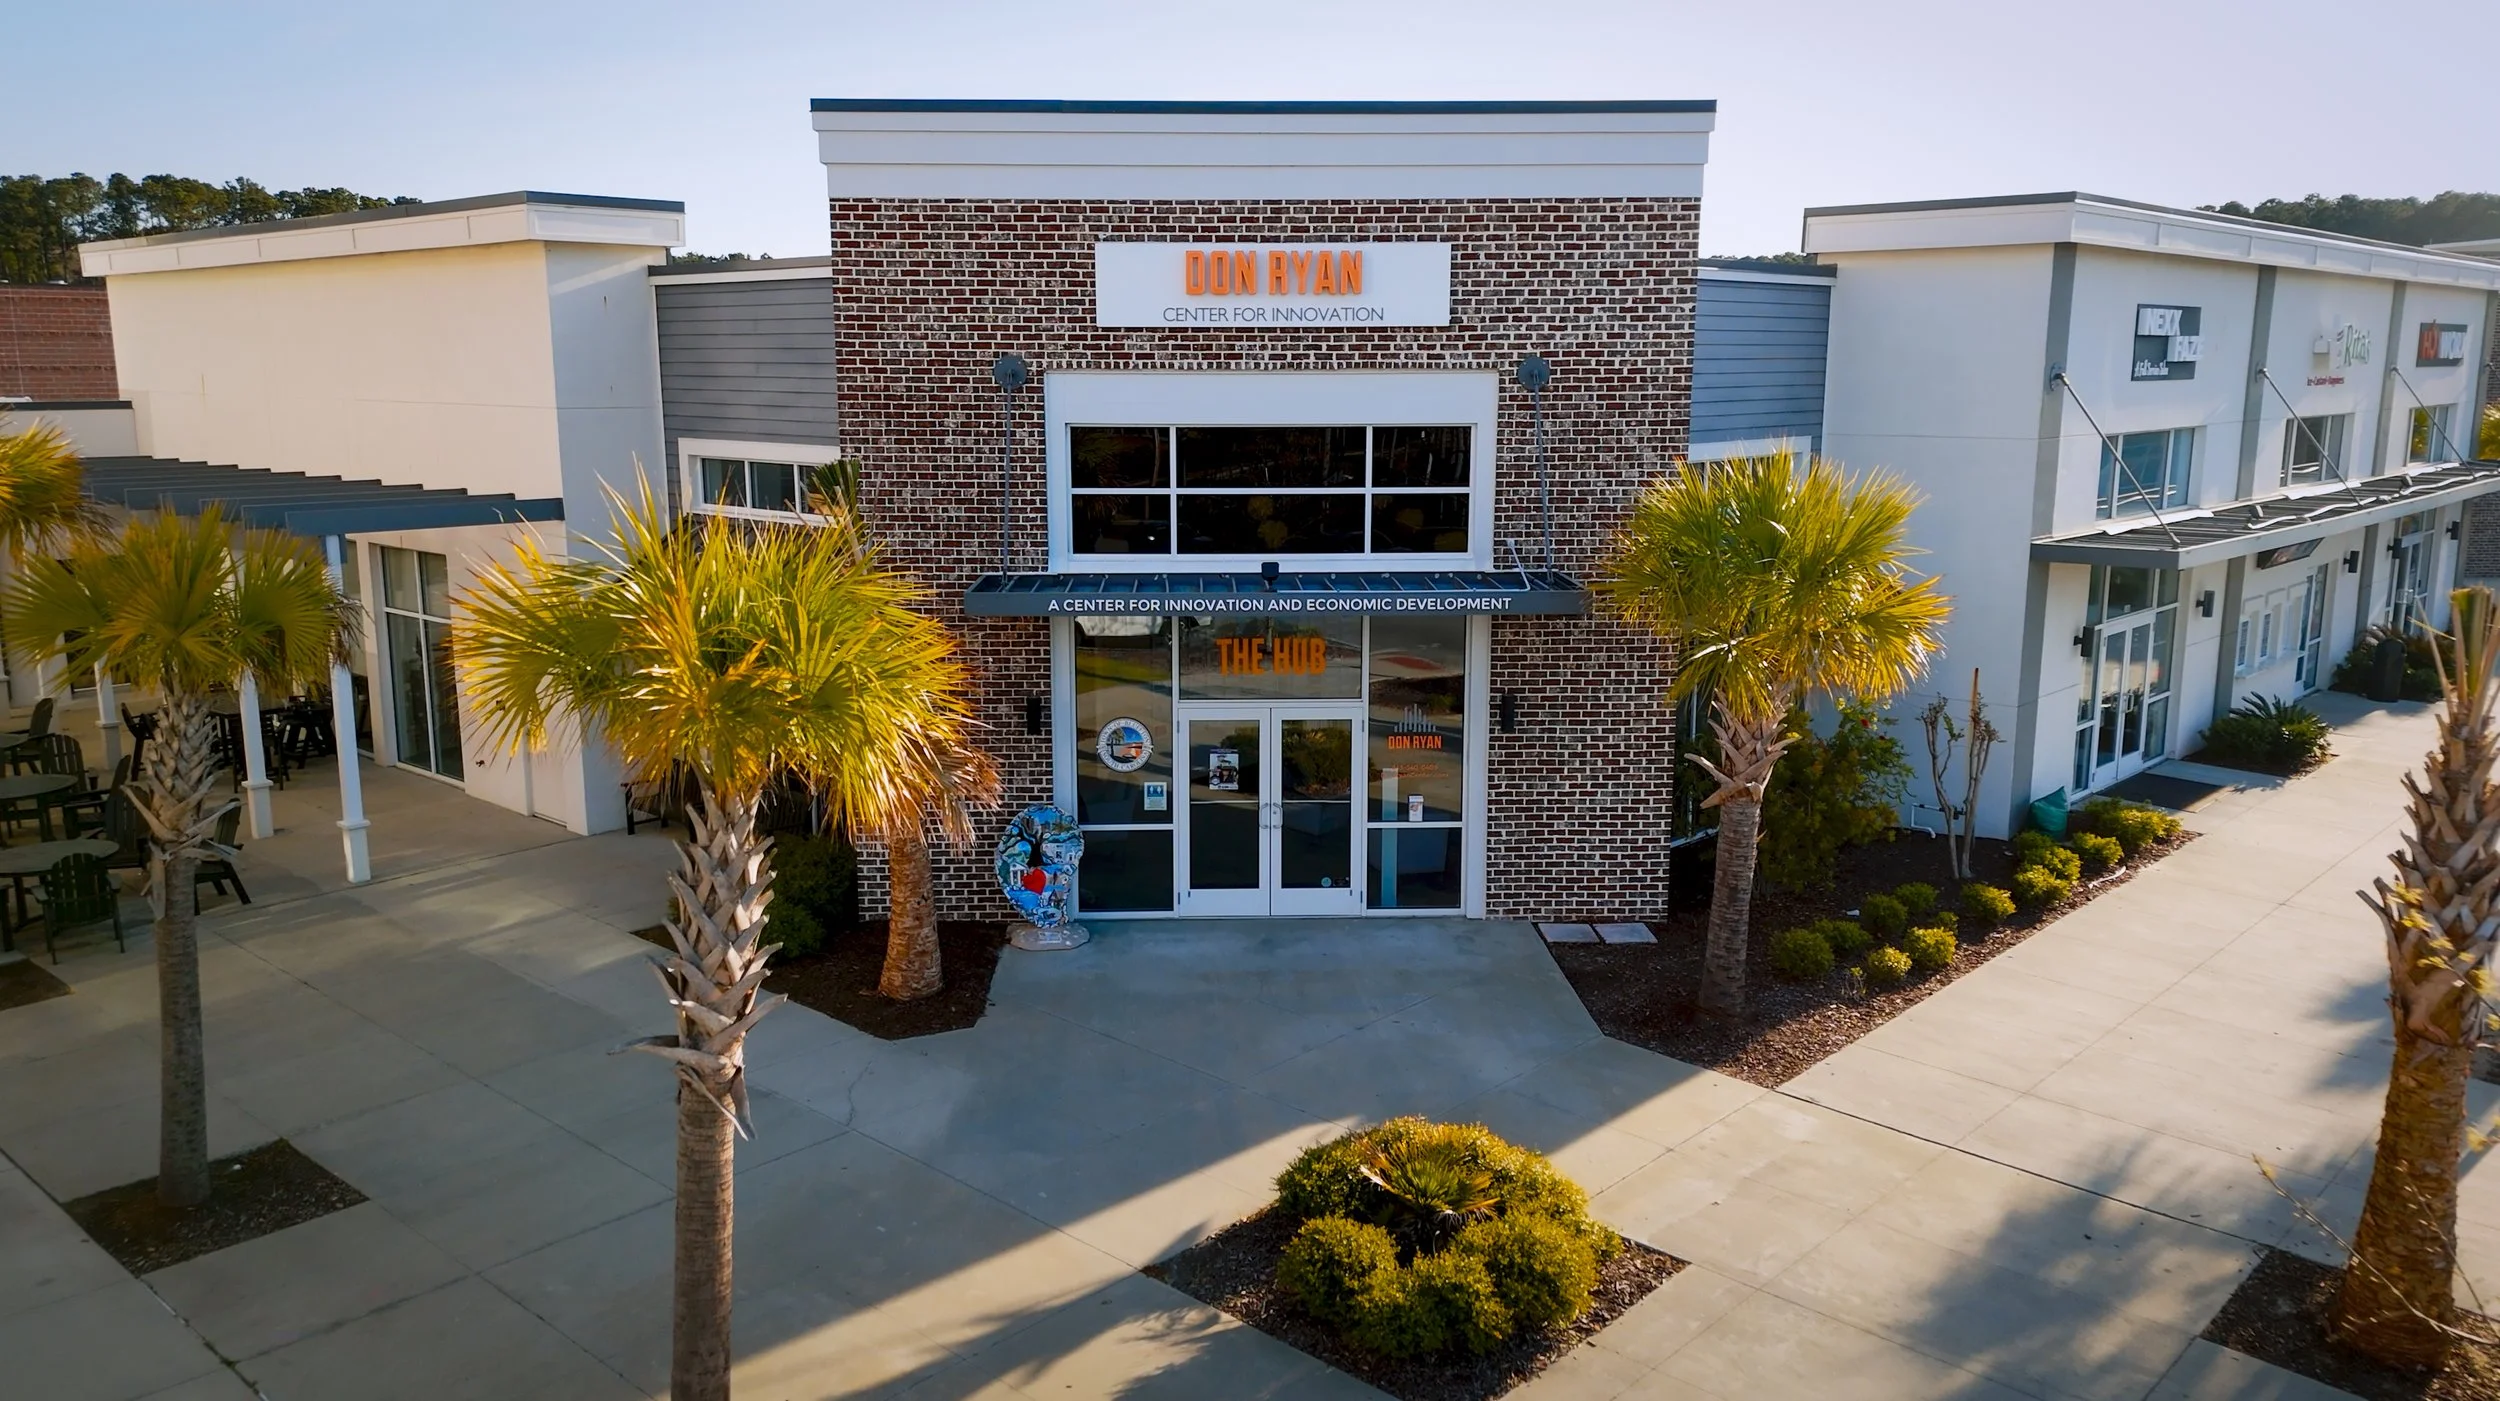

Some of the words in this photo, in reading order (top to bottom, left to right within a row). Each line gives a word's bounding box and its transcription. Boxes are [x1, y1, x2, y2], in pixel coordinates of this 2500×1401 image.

[1185, 249, 1257, 295] DON
[1268, 249, 1363, 295] RYAN
[1162, 306, 1228, 323] CENTER
[1233, 307, 1267, 323] FOR
[1271, 306, 1385, 323] INNOVATION
[2138, 308, 2182, 336] NEXX
[1048, 599, 1060, 612] A
[1063, 599, 1125, 612] CENTER
[1129, 599, 1161, 612] FOR
[1164, 599, 1266, 612] INNOVATION
[1268, 599, 1302, 612] AND
[1306, 598, 1393, 612] ECONOMIC
[1396, 597, 1512, 612] DEVELOPMENT
[1216, 638, 1265, 676] THE
[1272, 636, 1327, 676] HUB
[1388, 735, 1411, 749] DON
[1413, 735, 1442, 749] RYAN
